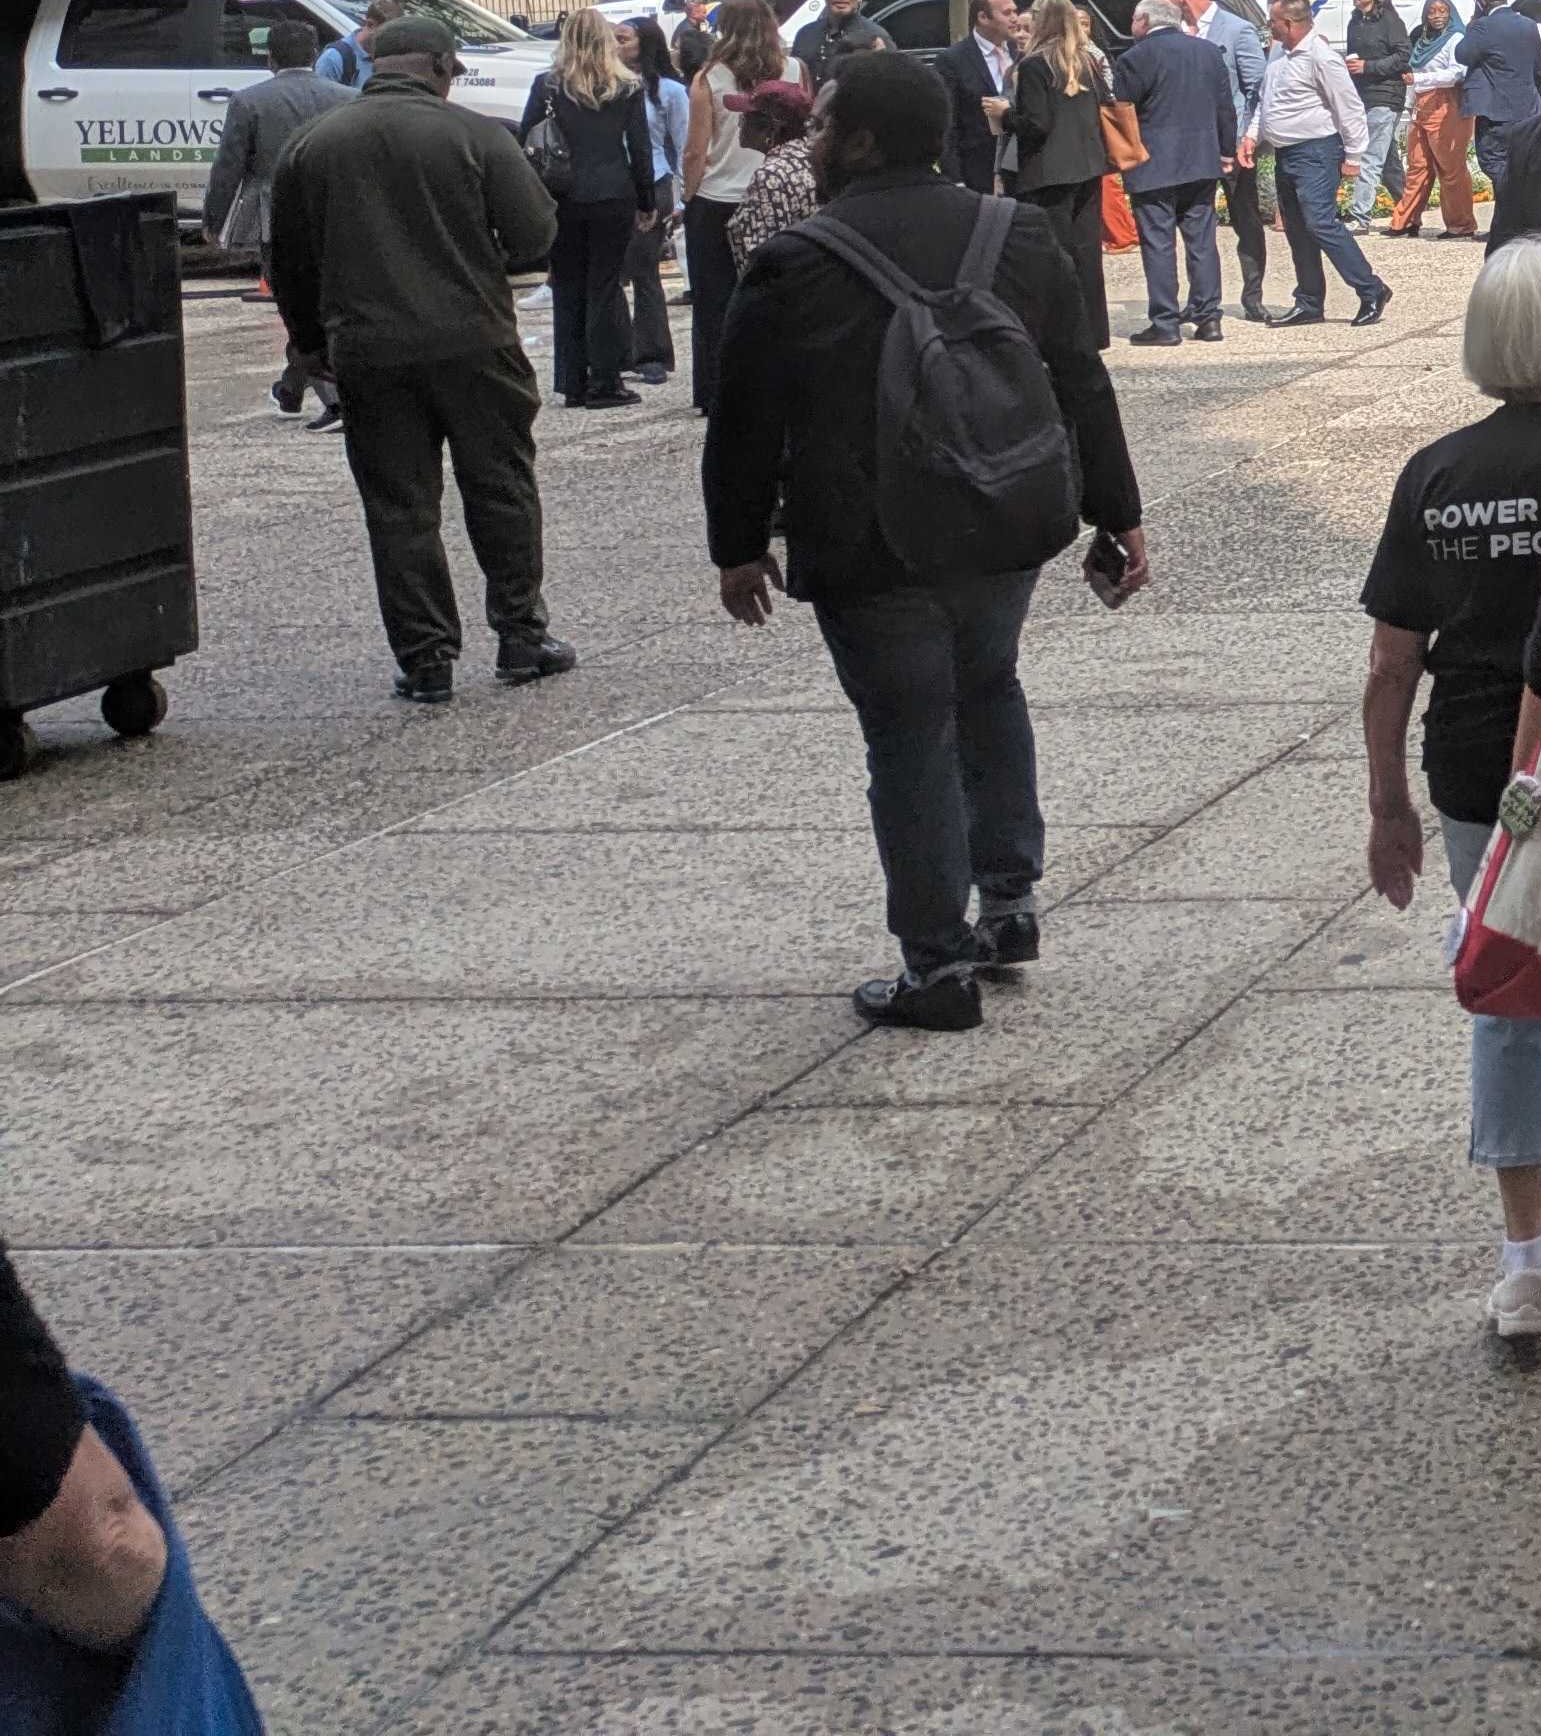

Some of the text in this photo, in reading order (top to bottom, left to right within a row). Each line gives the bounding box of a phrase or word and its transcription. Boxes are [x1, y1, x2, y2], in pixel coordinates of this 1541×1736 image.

[74, 119, 226, 146] YELLOWS
[109, 149, 205, 162] LANDS
[1424, 498, 1539, 531] POWER
[1426, 536, 1479, 561] THE
